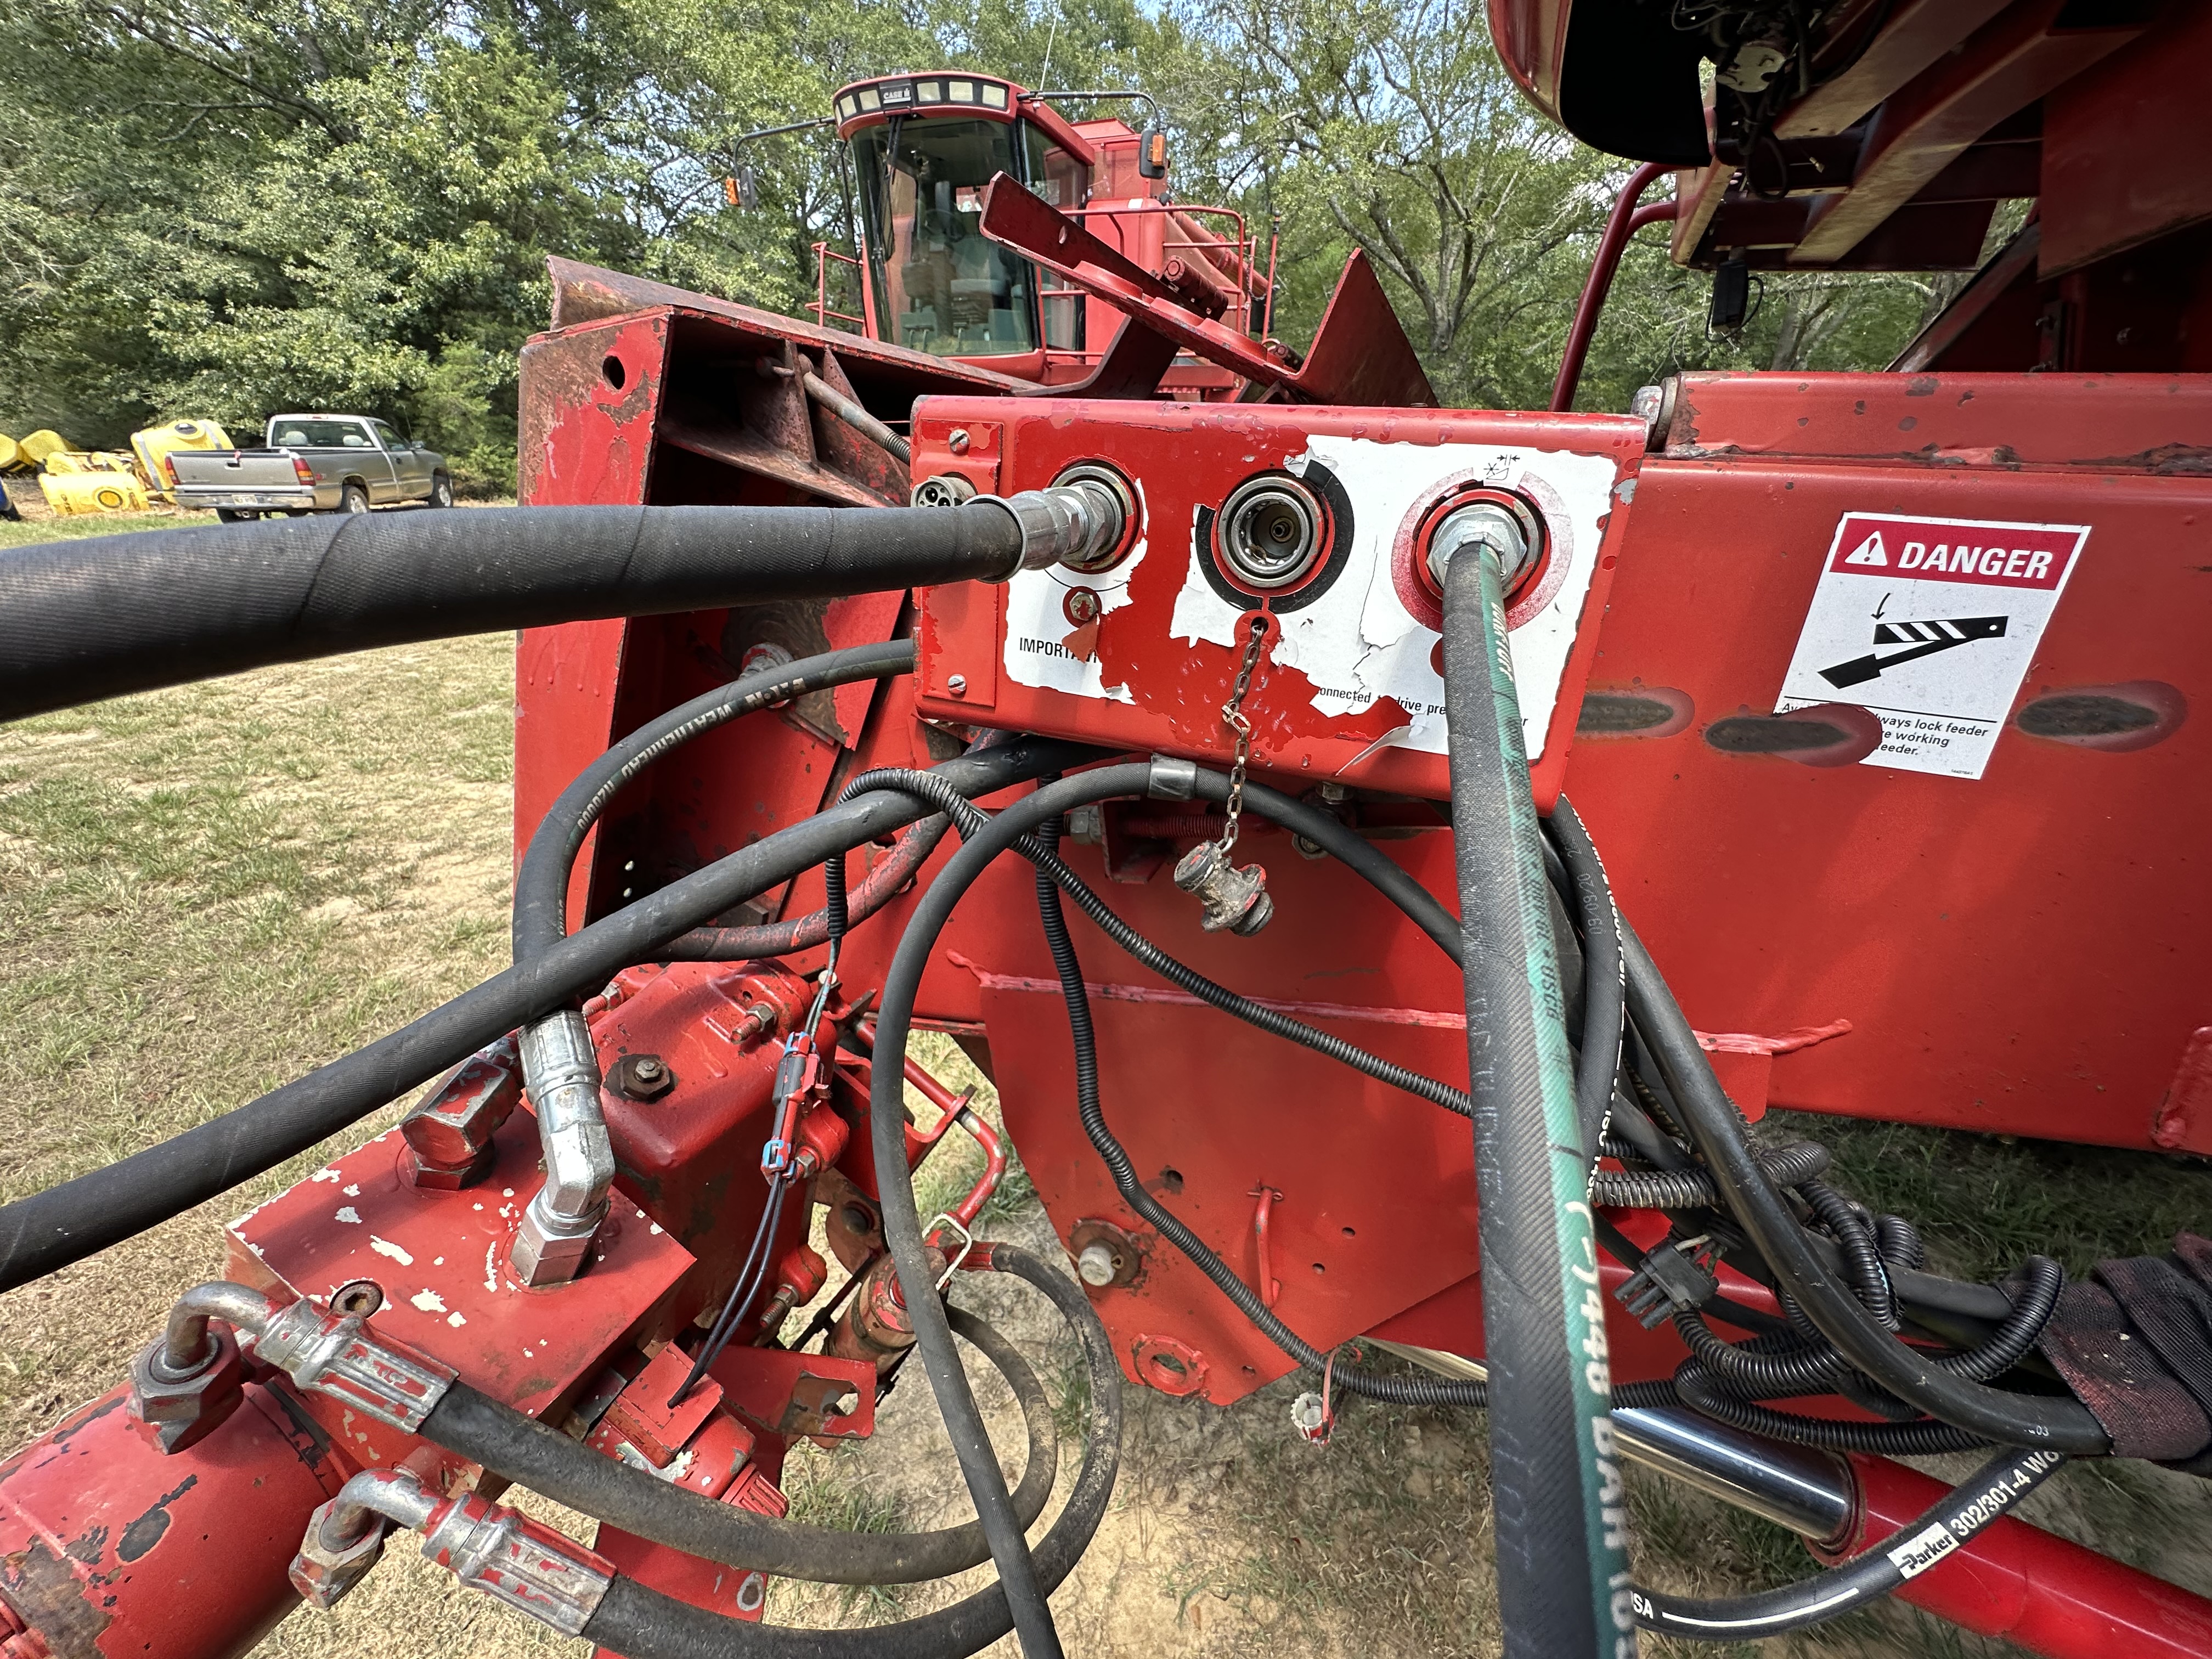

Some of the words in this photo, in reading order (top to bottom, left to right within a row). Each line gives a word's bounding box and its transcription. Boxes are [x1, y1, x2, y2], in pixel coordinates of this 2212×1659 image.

[883, 91, 902, 99] CASE
[1898, 541, 2053, 579] DANGER
[1318, 687, 1372, 703] onnected
[1876, 713, 1911, 729] ways
[1915, 719, 1942, 731] lock
[1945, 723, 1988, 737] feeder
[1875, 744, 1918, 755] eeder.
[1896, 732, 1950, 747] working
[1899, 1533, 1953, 1570] Parker
[1950, 1469, 2032, 1536] 302/301-4
[1630, 1591, 1654, 1620] SA
